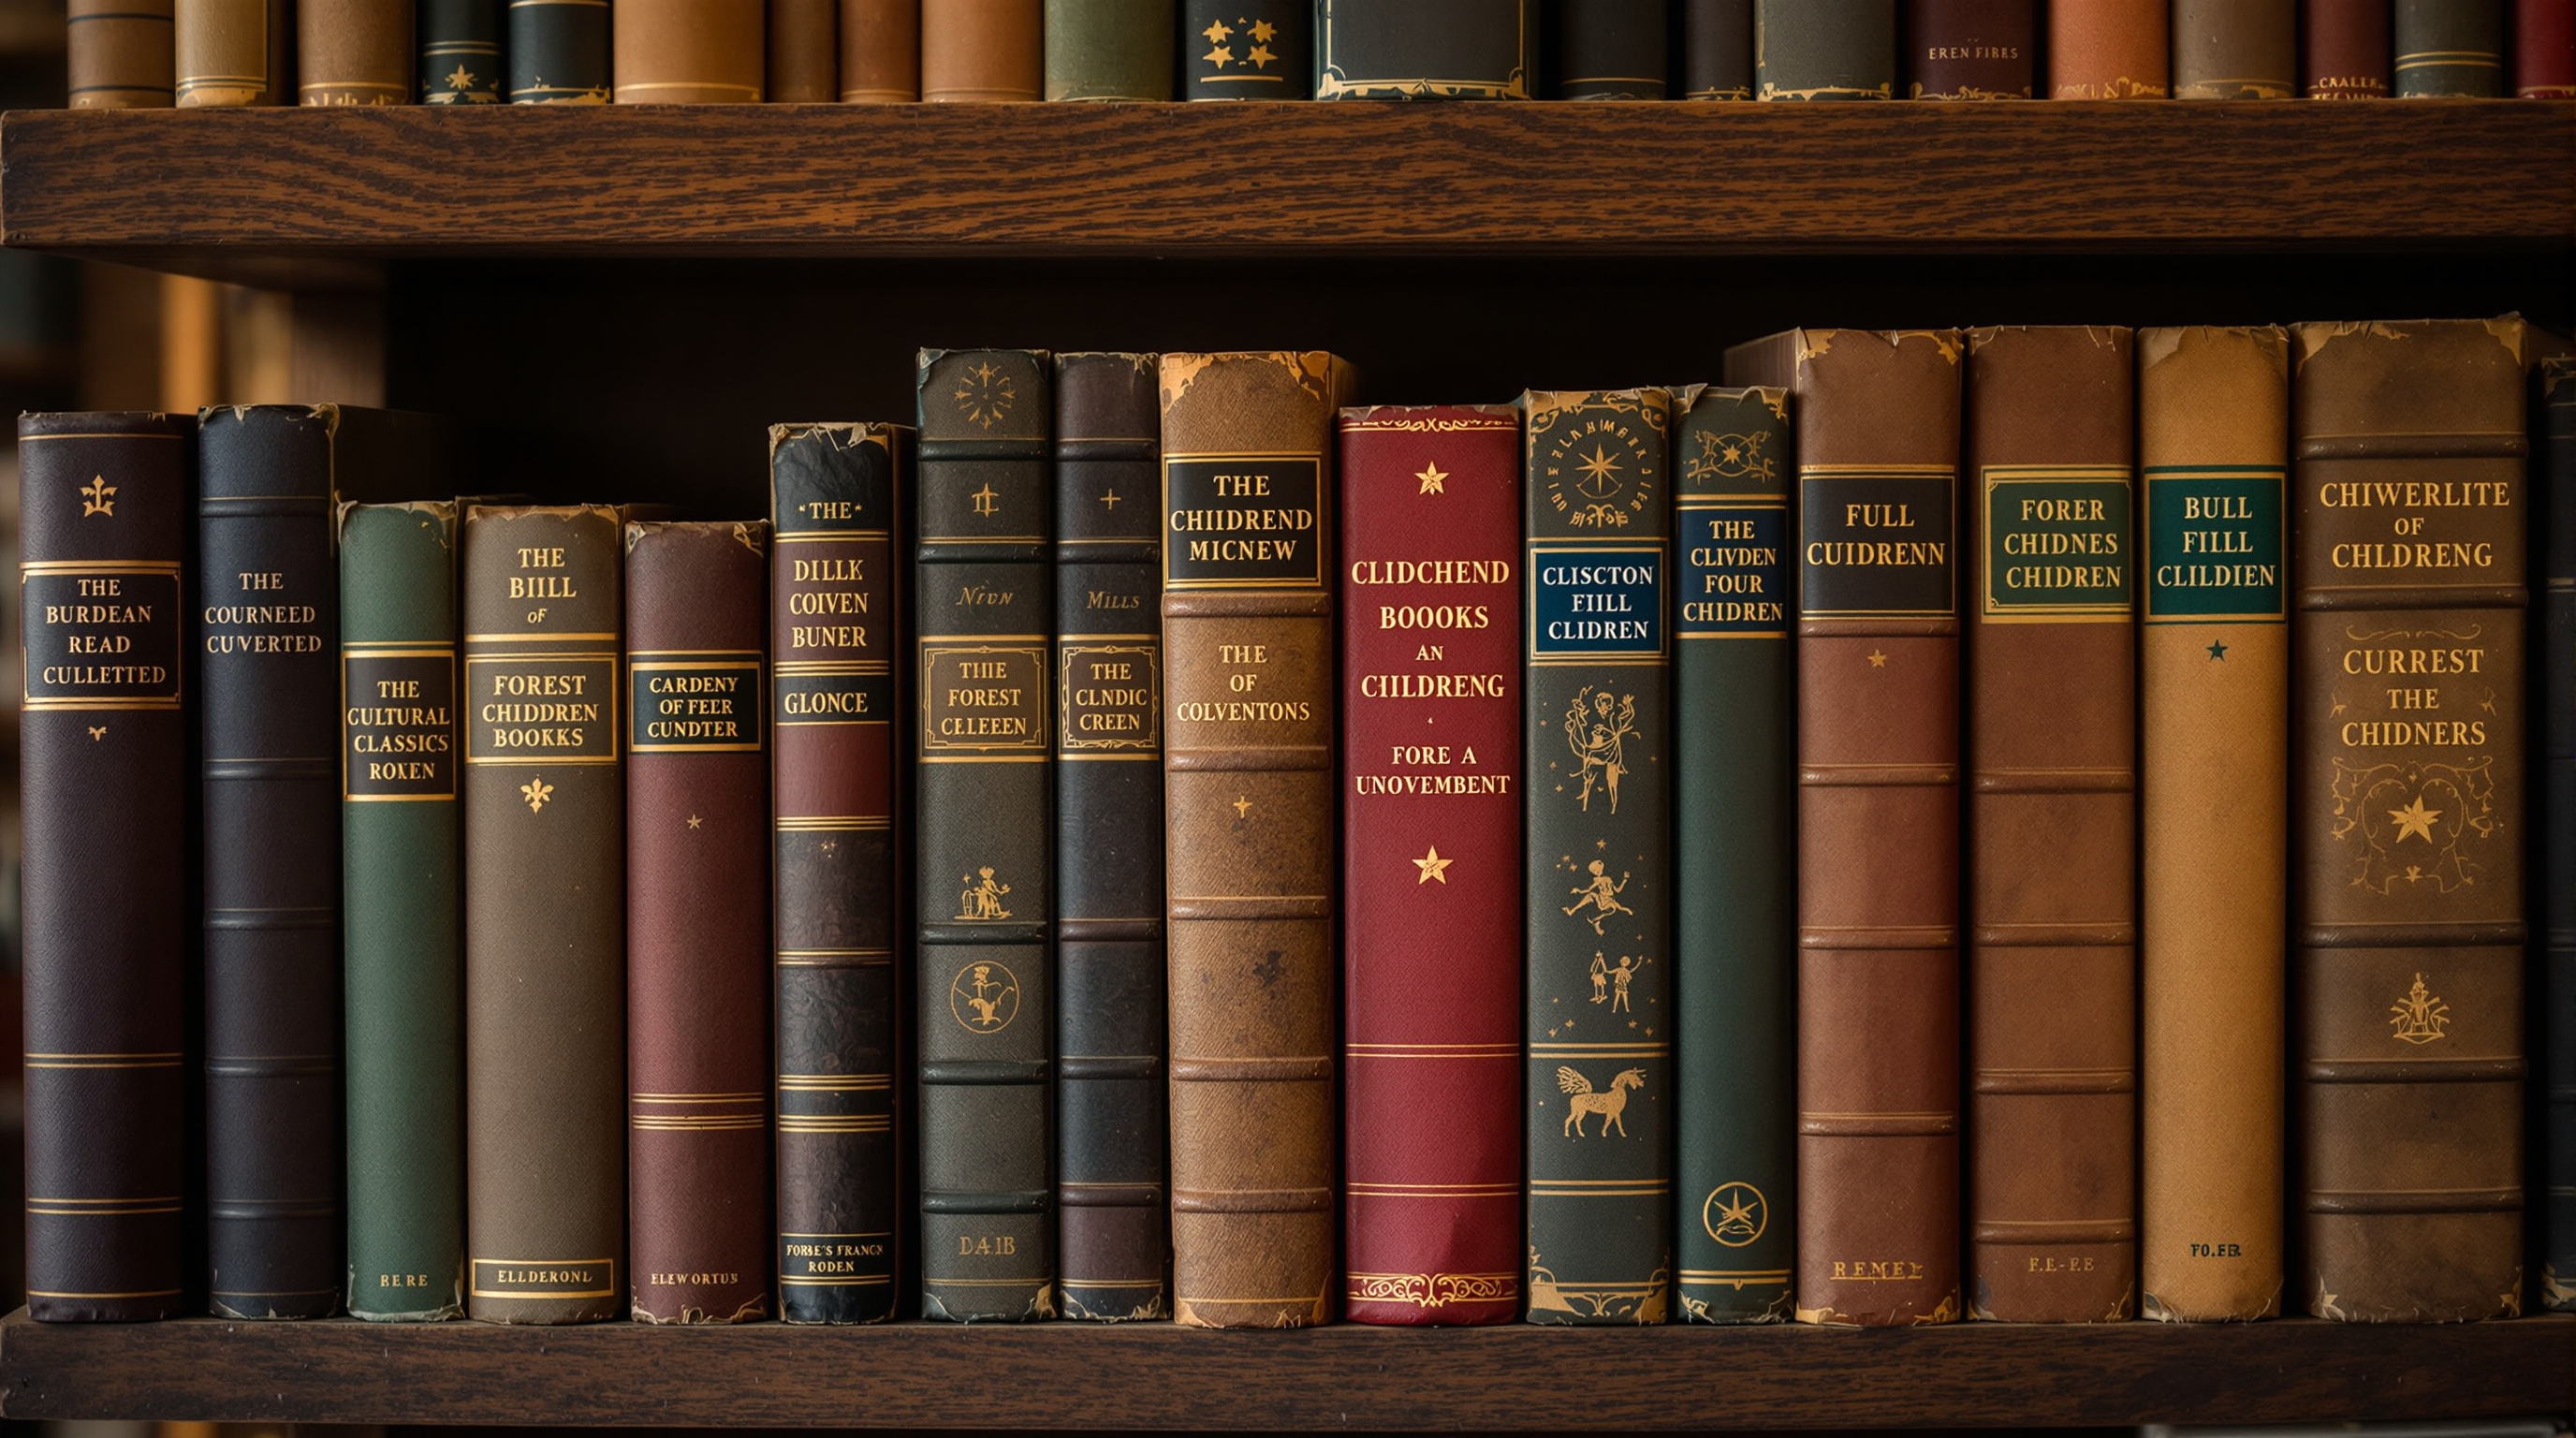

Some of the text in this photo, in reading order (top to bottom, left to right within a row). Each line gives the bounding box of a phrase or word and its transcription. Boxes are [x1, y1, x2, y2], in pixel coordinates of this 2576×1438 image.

[1213, 475, 1270, 497] THE
[2320, 481, 2510, 508] CHIWERLITE
[809, 502, 853, 520] THE
[1845, 504, 1916, 527] FULL
[2021, 499, 2106, 521] FORER
[2184, 496, 2253, 520] BULL
[1709, 521, 1755, 540] THE
[2393, 518, 2425, 536] OF
[1189, 540, 1297, 562] MICNEW
[2004, 533, 2118, 555] CHIDNES
[518, 549, 565, 568] THE
[1690, 548, 1777, 567] CLIVDEN
[1807, 542, 1946, 566] CUIDRENN
[2332, 542, 2494, 568] CHLDRENG
[793, 560, 865, 581] DILLK
[1351, 560, 1510, 585] CLIDCHEND
[1543, 566, 1654, 585] CLISCTON
[2006, 565, 2122, 589] CHIDREN
[78, 579, 122, 596] THE
[239, 572, 285, 591] THE
[1705, 574, 1764, 594] FOUR
[789, 592, 870, 616] COIVEN
[1683, 602, 1784, 623] CHIDREN
[46, 605, 153, 624] BURDEAN
[204, 606, 316, 624] COURNEED
[1380, 605, 1489, 629] BOOOKS
[792, 626, 868, 648] BUNER
[1548, 621, 1649, 640] CLIDREN
[68, 636, 131, 654] READ
[1219, 645, 1267, 664] THE
[1415, 645, 1444, 661] AN
[2342, 649, 2485, 675] CURREST
[43, 666, 167, 685] CULLETTED
[1090, 663, 1132, 681] THE
[377, 681, 420, 698] THE
[493, 675, 587, 696] FOREST
[650, 676, 739, 694] CARDENY
[1229, 674, 1257, 692] OF
[659, 698, 684, 715] OF
[784, 692, 870, 714] GLONCE
[948, 689, 1022, 707] FOREST
[2386, 688, 2440, 710] THE
[481, 704, 599, 723] CHIDDREN
[1177, 702, 1311, 722] COLVENTONS
[647, 722, 739, 739] CUNDTER
[1079, 713, 1141, 731] CREEN
[492, 727, 585, 748] BOOKKS
[2341, 722, 2487, 747] CHIDNERS
[354, 735, 449, 754] CLASSICS
[1392, 746, 1477, 766] FORE A
[1355, 775, 1511, 795] UNOVEMBENT
[808, 1261, 855, 1272] RODEN
